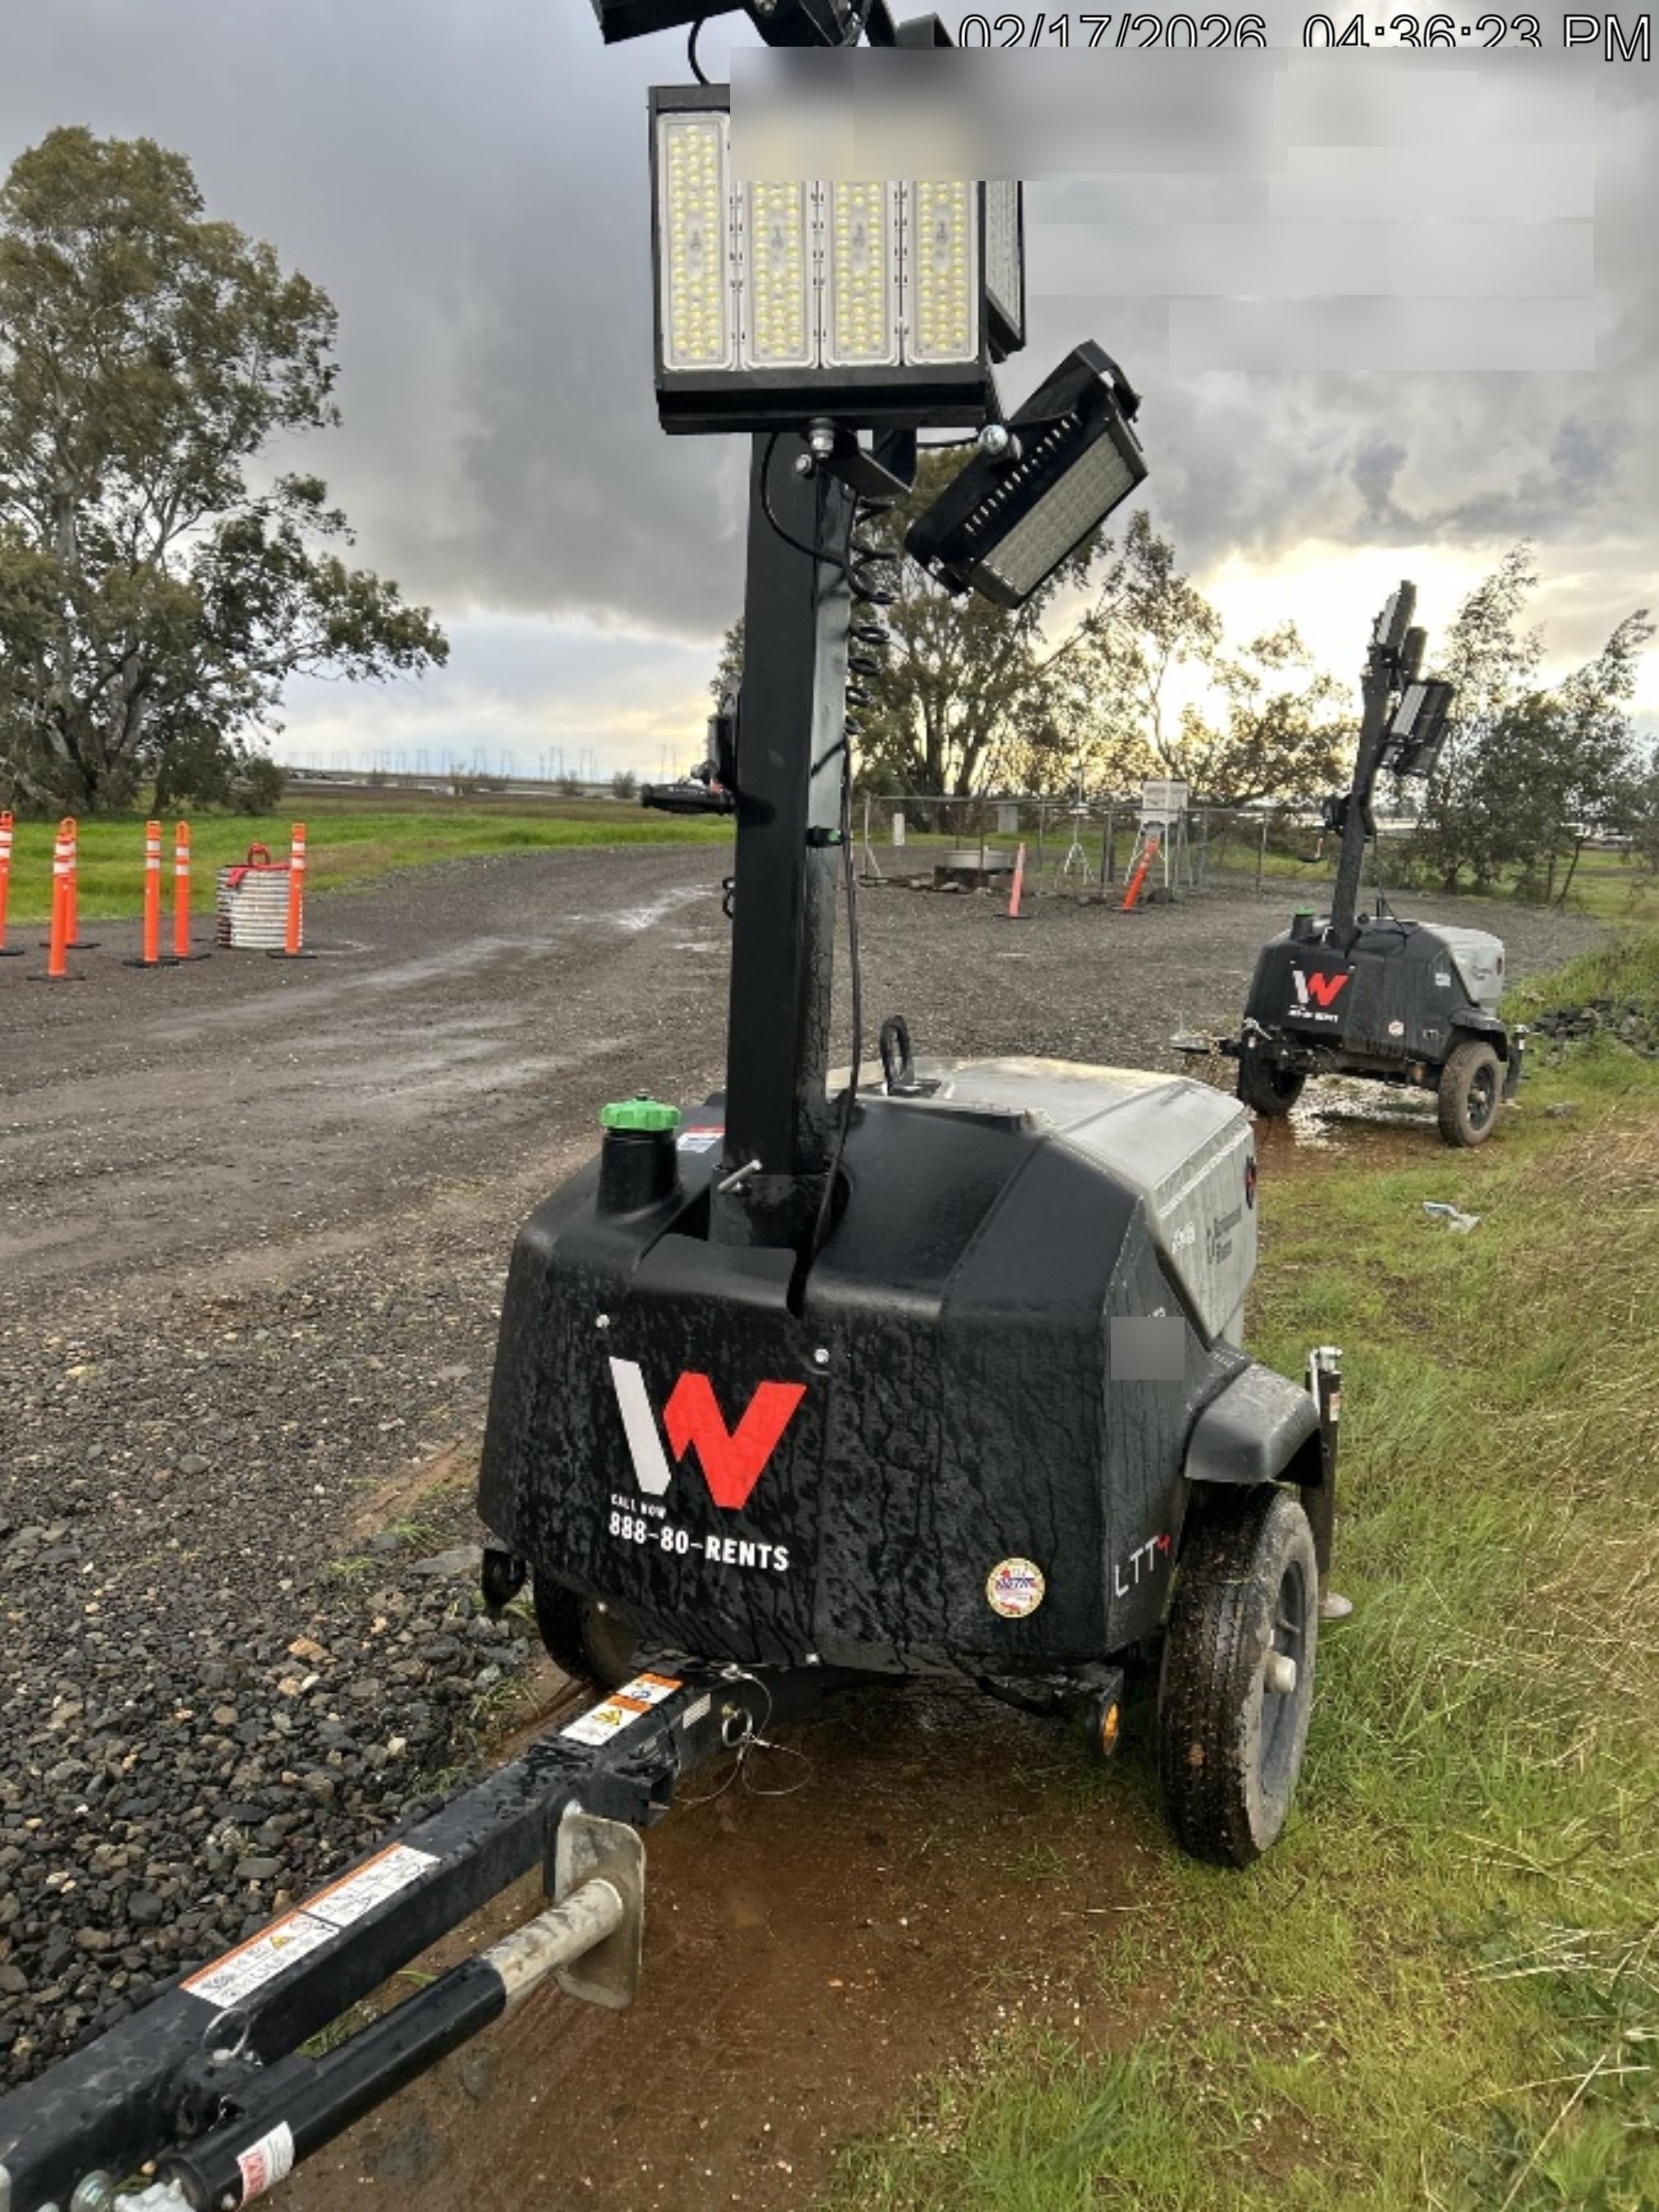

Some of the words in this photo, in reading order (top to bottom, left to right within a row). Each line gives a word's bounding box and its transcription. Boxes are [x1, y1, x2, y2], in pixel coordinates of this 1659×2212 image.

[611, 1494, 637, 1512] CALL
[641, 1502, 666, 1519] NOW
[610, 1512, 790, 1571] 888-80-RENTS
